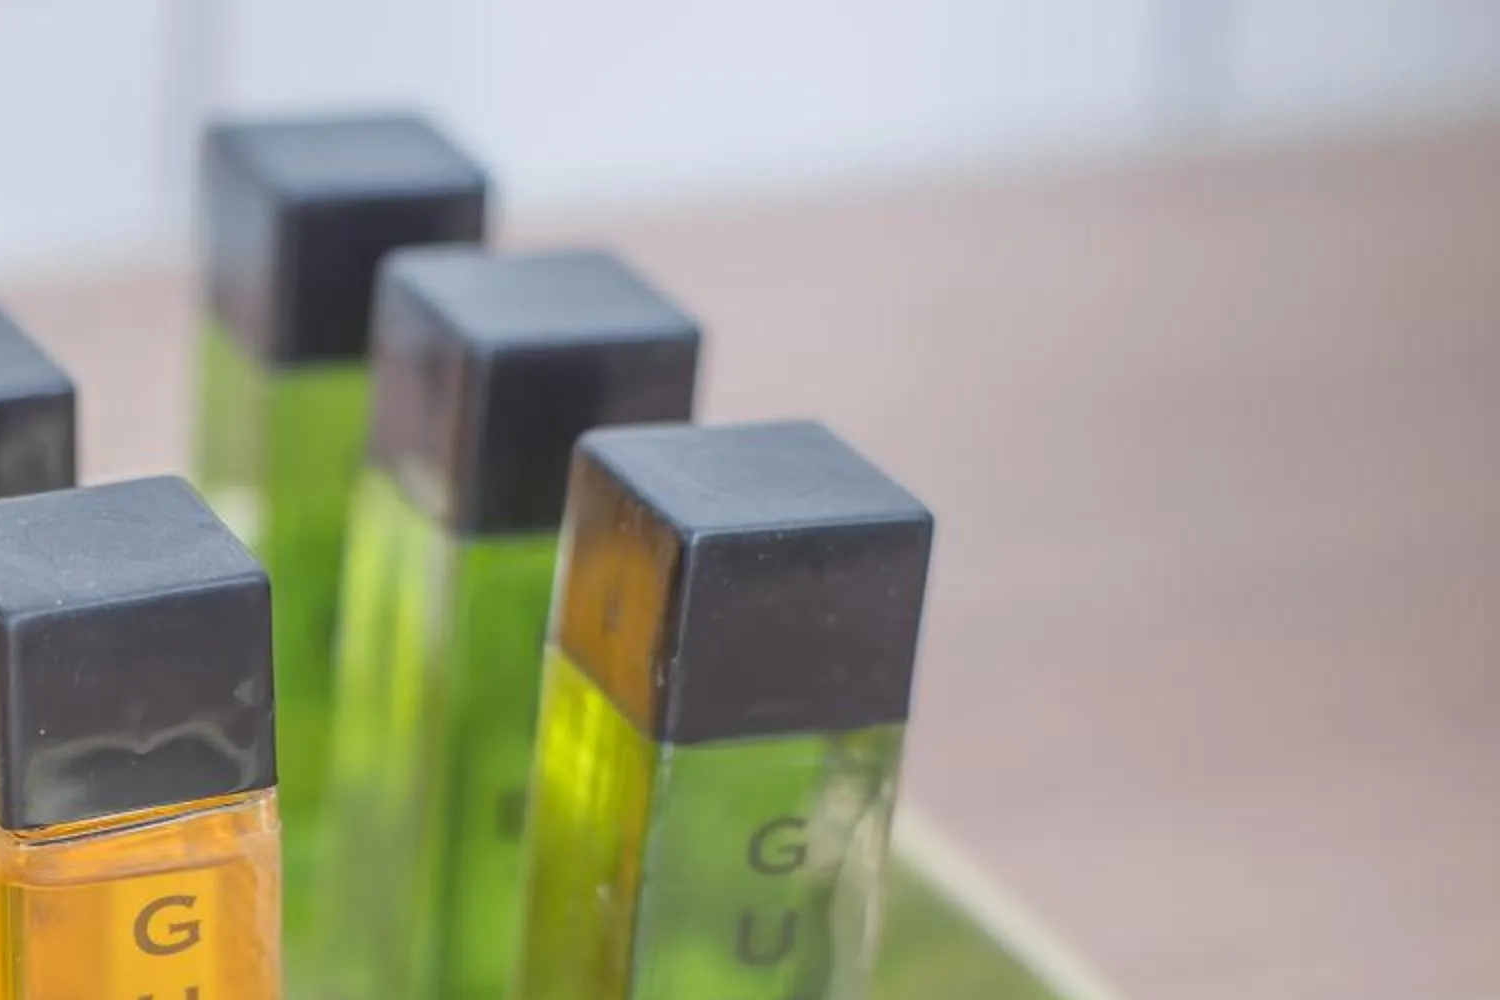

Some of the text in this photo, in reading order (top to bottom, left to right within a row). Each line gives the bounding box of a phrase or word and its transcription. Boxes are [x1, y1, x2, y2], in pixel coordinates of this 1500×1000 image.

[745, 816, 807, 876] G
[133, 894, 202, 957] G
[735, 909, 800, 967] U
